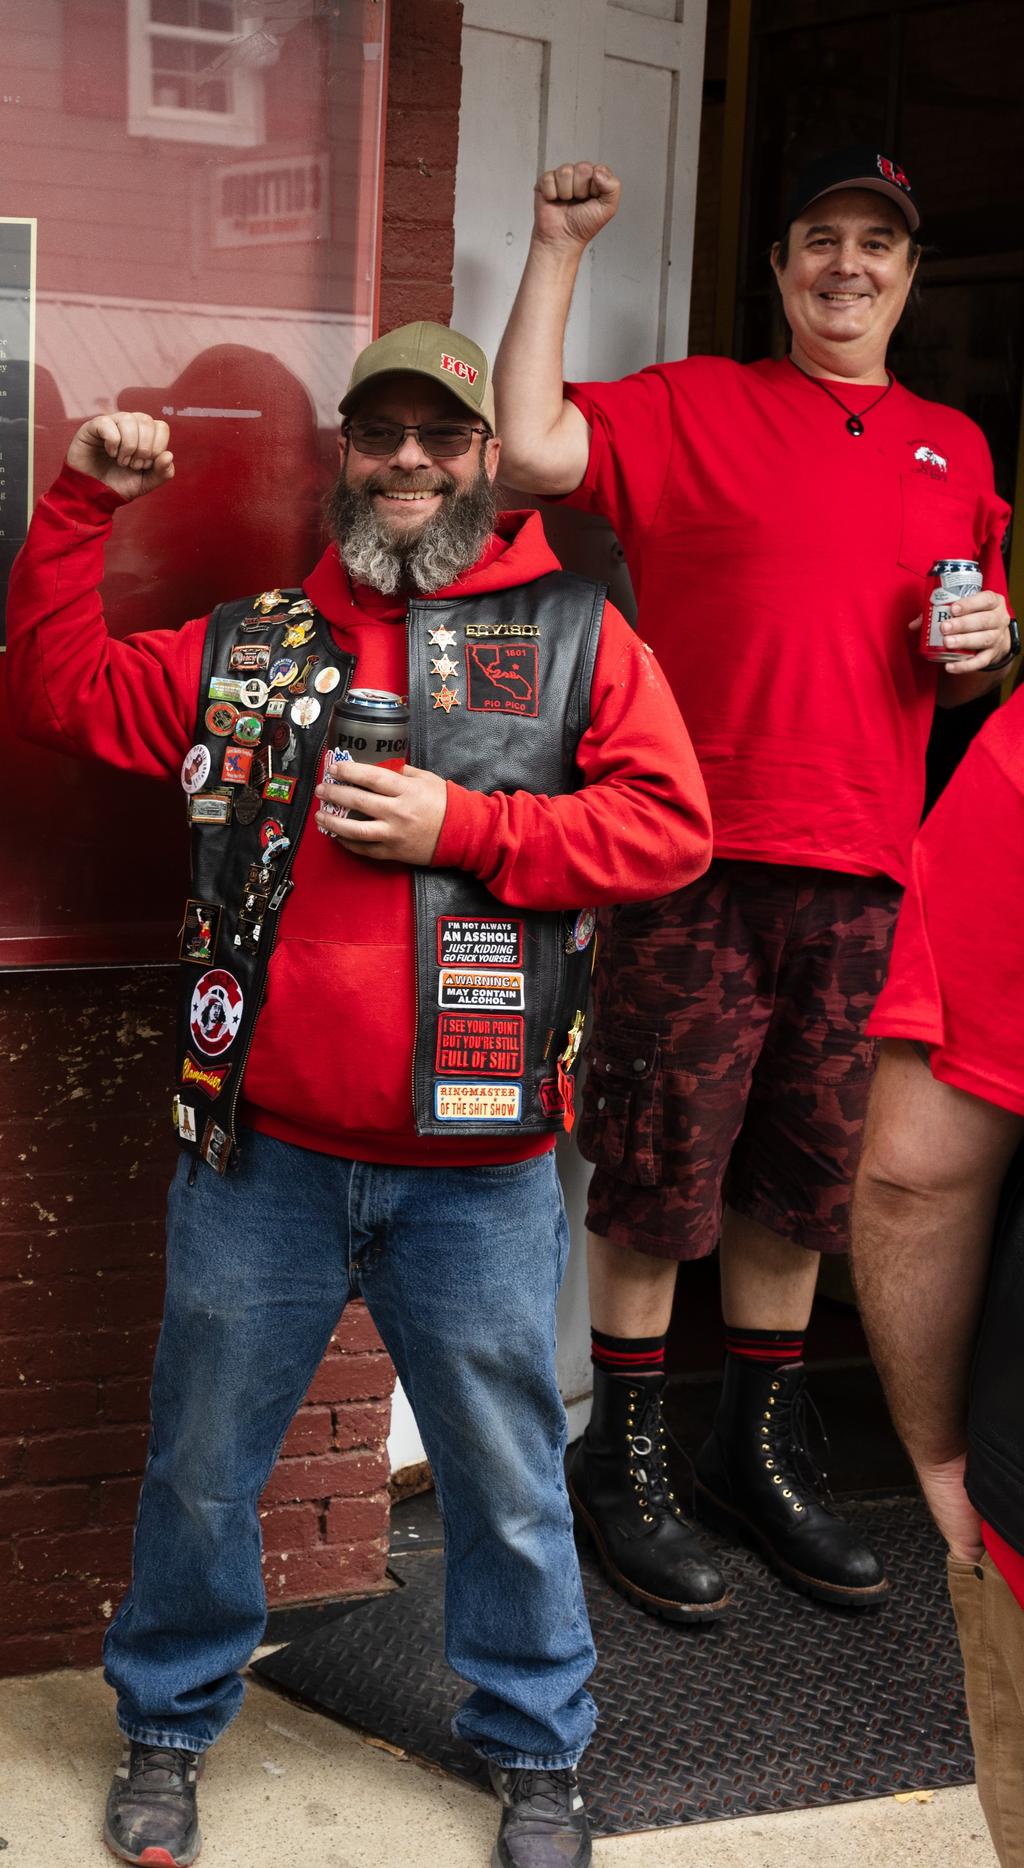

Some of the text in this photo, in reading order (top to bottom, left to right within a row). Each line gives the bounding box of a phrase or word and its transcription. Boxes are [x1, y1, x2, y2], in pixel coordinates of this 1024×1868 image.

[441, 353, 478, 385] ECV
[484, 700, 526, 711] PIO PICO
[338, 733, 366, 750] PIO
[443, 932, 517, 943] AN ASSHOLE
[445, 944, 514, 954] JUST KIDDING
[457, 954, 477, 962] FUCK
[478, 955, 517, 963] YOURSELF
[454, 975, 510, 987] WARNING
[447, 988, 517, 998] MAY CONTAIN
[458, 996, 506, 1005] ALCOHOL
[443, 1020, 518, 1034] I SEE YOUR POINT
[443, 1036, 518, 1050] BUT YOU'RE STILL
[442, 1052, 518, 1070] FULL OF SHIT
[440, 1088, 515, 1096] RINGMASTER
[441, 1103, 515, 1116] OF THE SHIT SHOW
